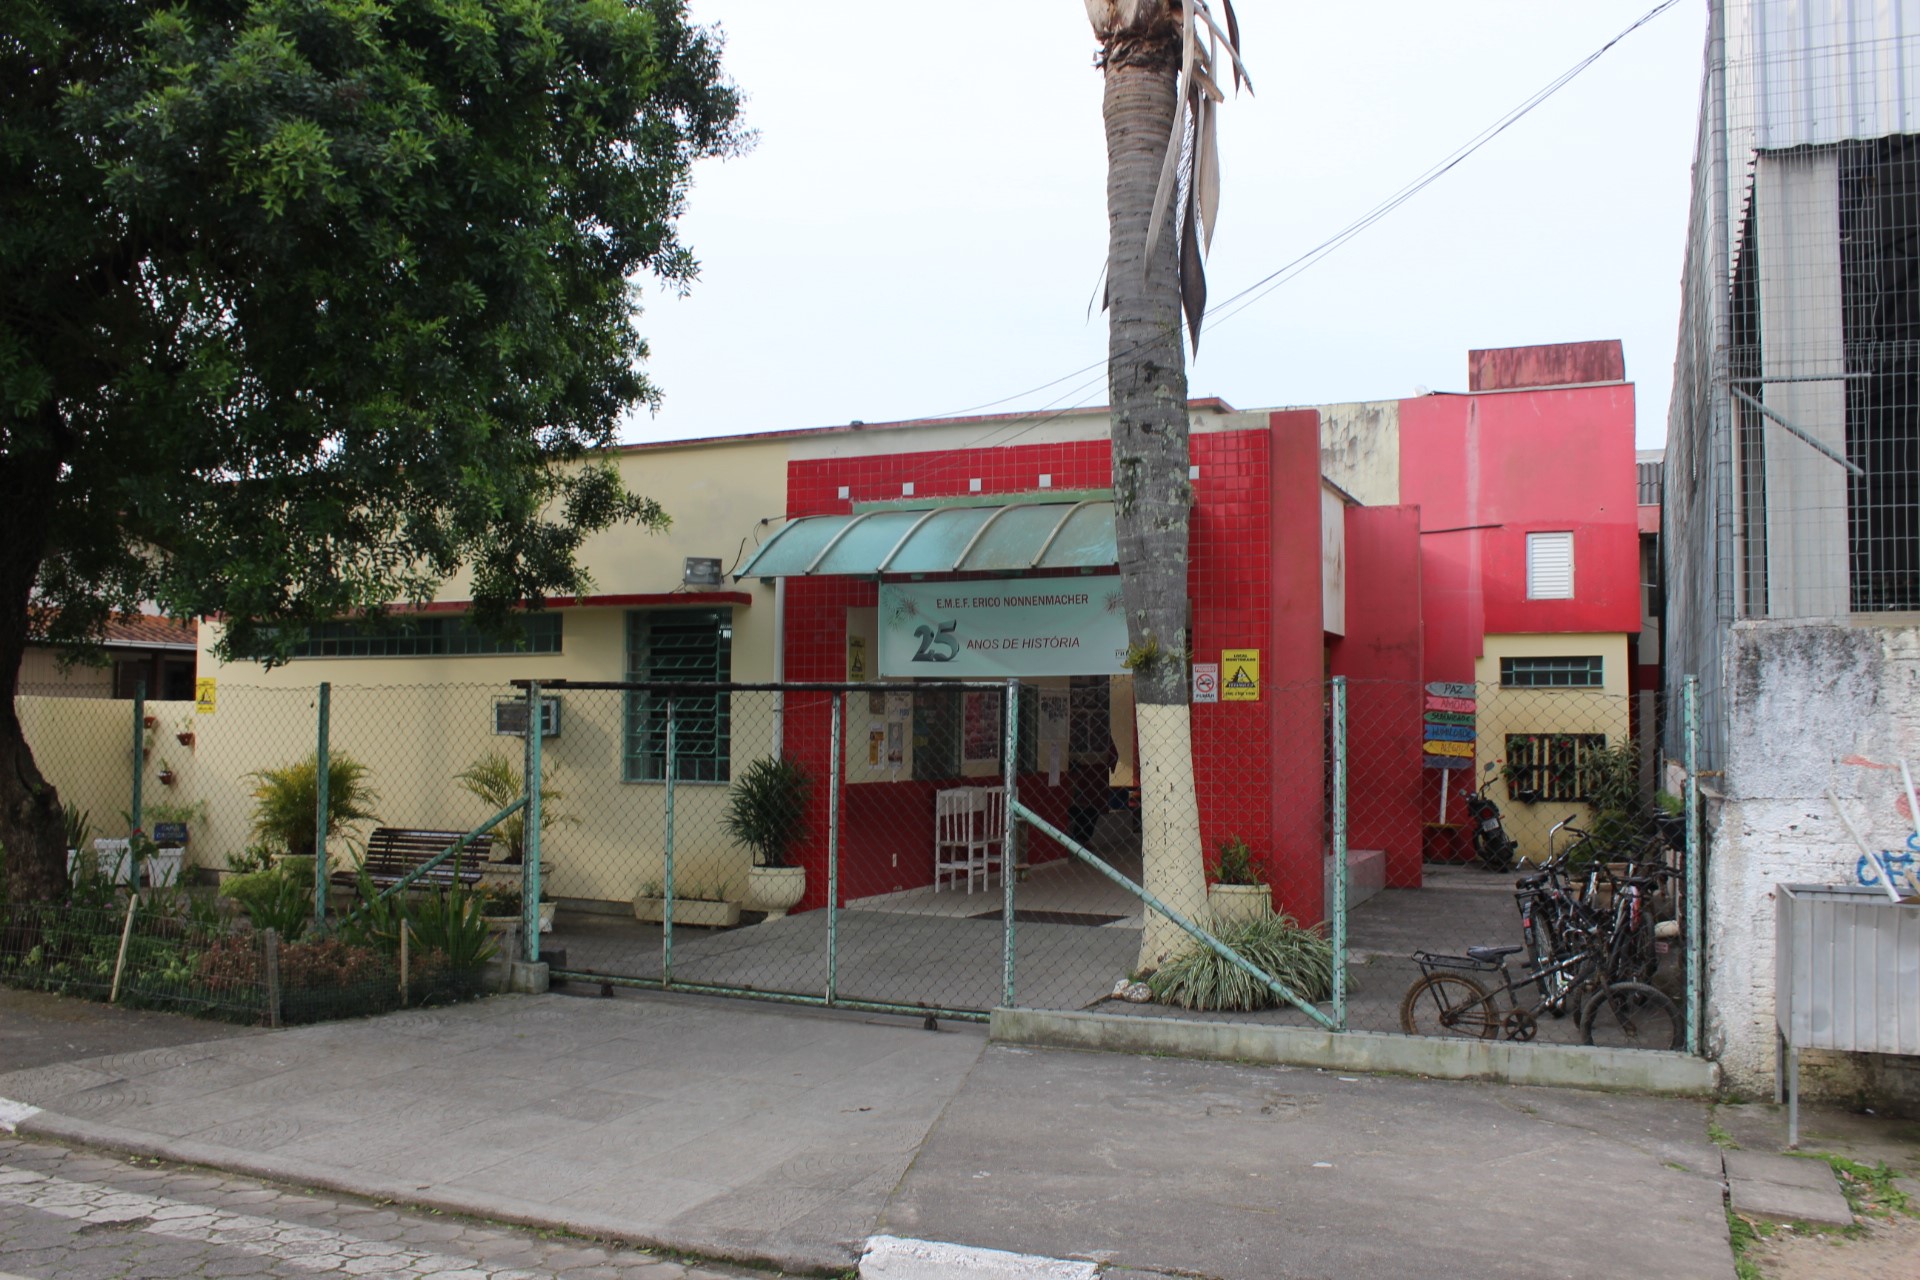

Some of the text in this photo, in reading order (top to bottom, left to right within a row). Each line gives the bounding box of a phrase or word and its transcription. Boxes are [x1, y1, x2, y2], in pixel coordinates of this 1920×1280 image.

[936, 593, 1089, 609] E.M.E.F. ERICO NONNENMACHER
[911, 619, 1080, 662] 25 ANOS DE HISTÓRIA
[1443, 683, 1463, 695] PAZ
